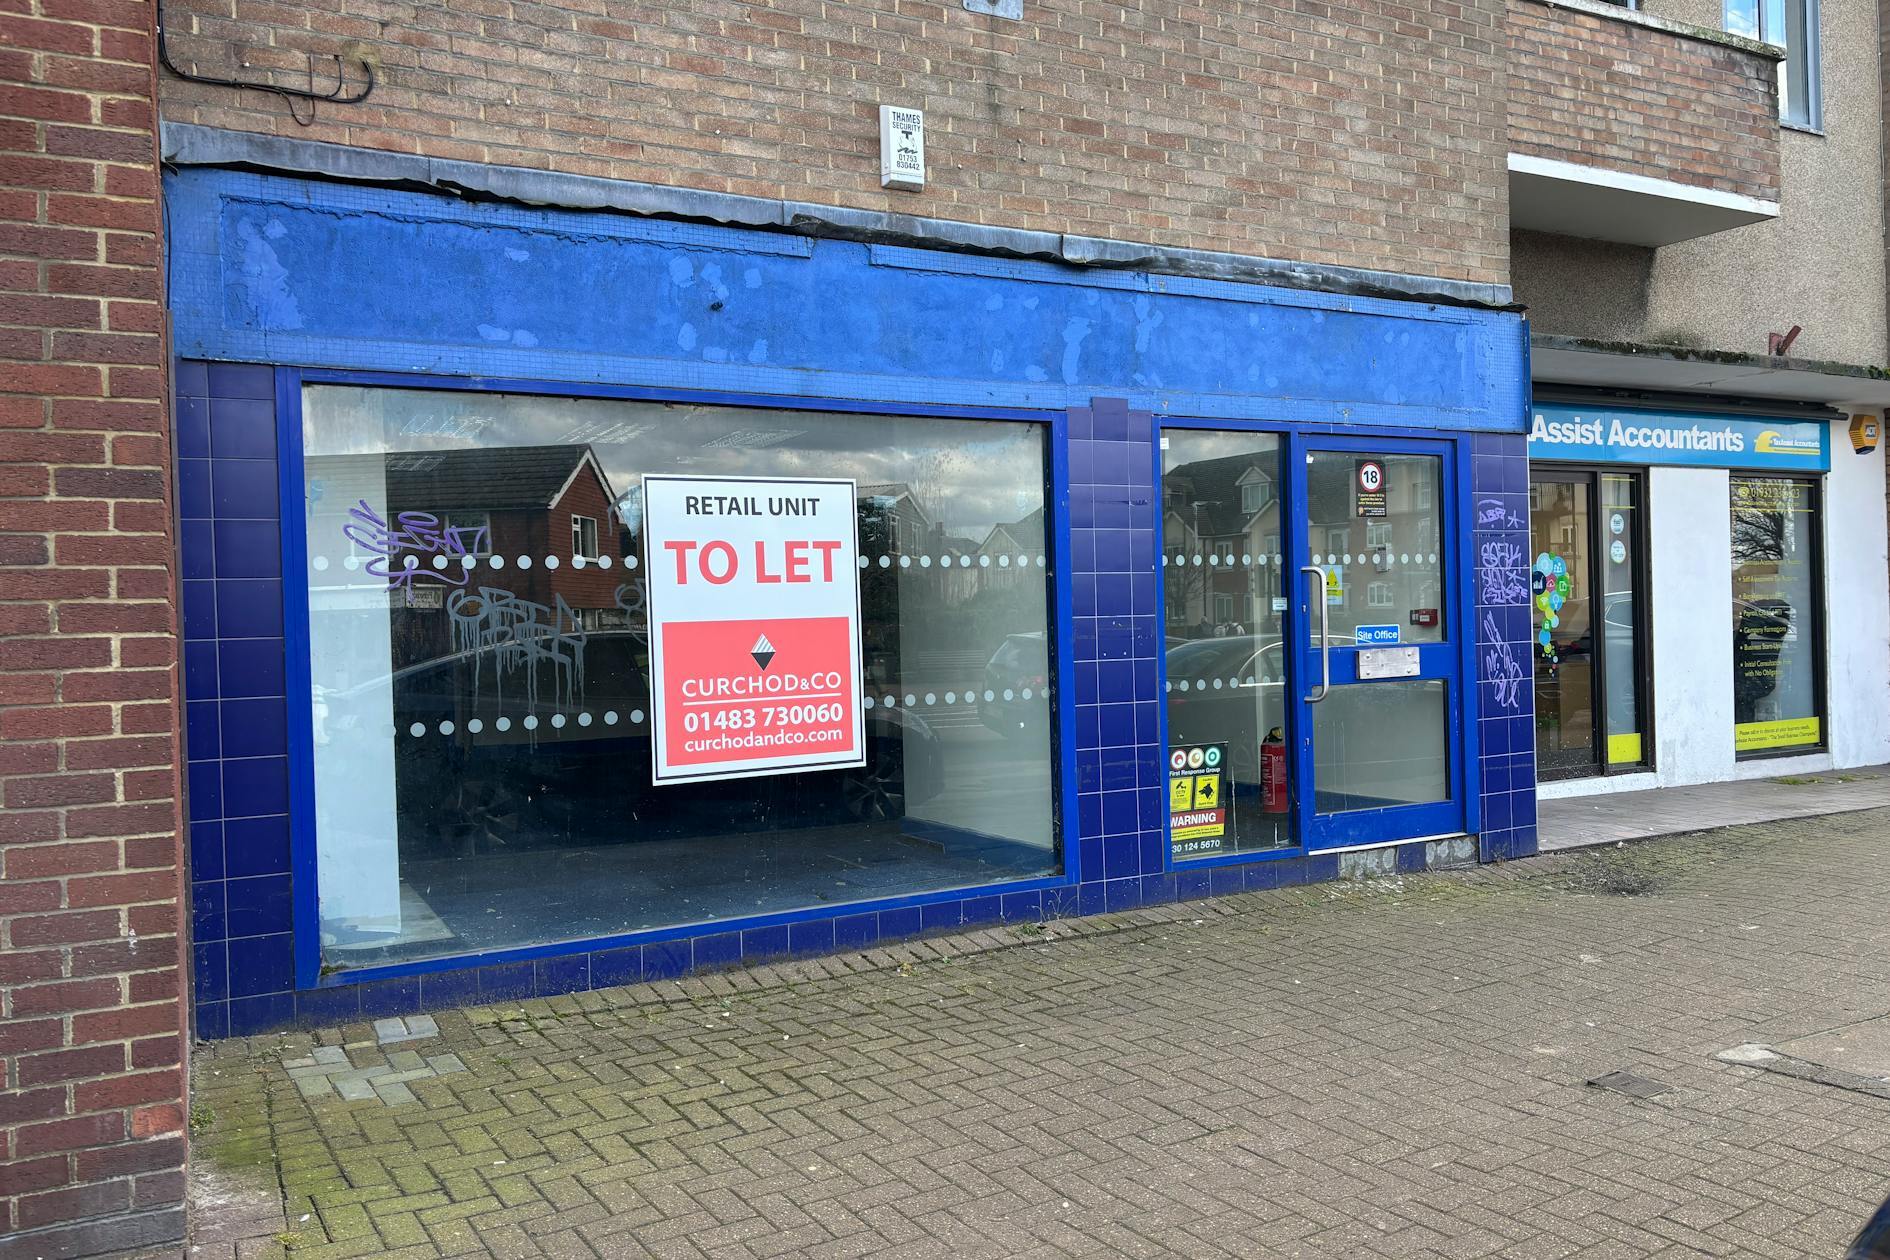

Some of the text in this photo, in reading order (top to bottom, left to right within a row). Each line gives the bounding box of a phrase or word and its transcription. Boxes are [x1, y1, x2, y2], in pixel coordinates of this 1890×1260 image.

[892, 111, 920, 124] THAMES
[892, 122, 921, 132] SECURITY
[898, 154, 917, 162] 01753
[896, 161, 920, 170] 830442
[1529, 414, 1745, 452] Assist Accountants
[1363, 470, 1378, 483] 18
[685, 496, 820, 517] RETAIL UNIT
[664, 540, 842, 585] TO LET
[1357, 629, 1398, 640] Site Office
[682, 672, 841, 697] CURCHOD&CO
[684, 703, 843, 733] 01483 730060
[684, 728, 843, 752] curchodandco.com
[1171, 812, 1216, 827] WARNING
[1184, 842, 1198, 851] 124
[1200, 840, 1220, 849] 5670
